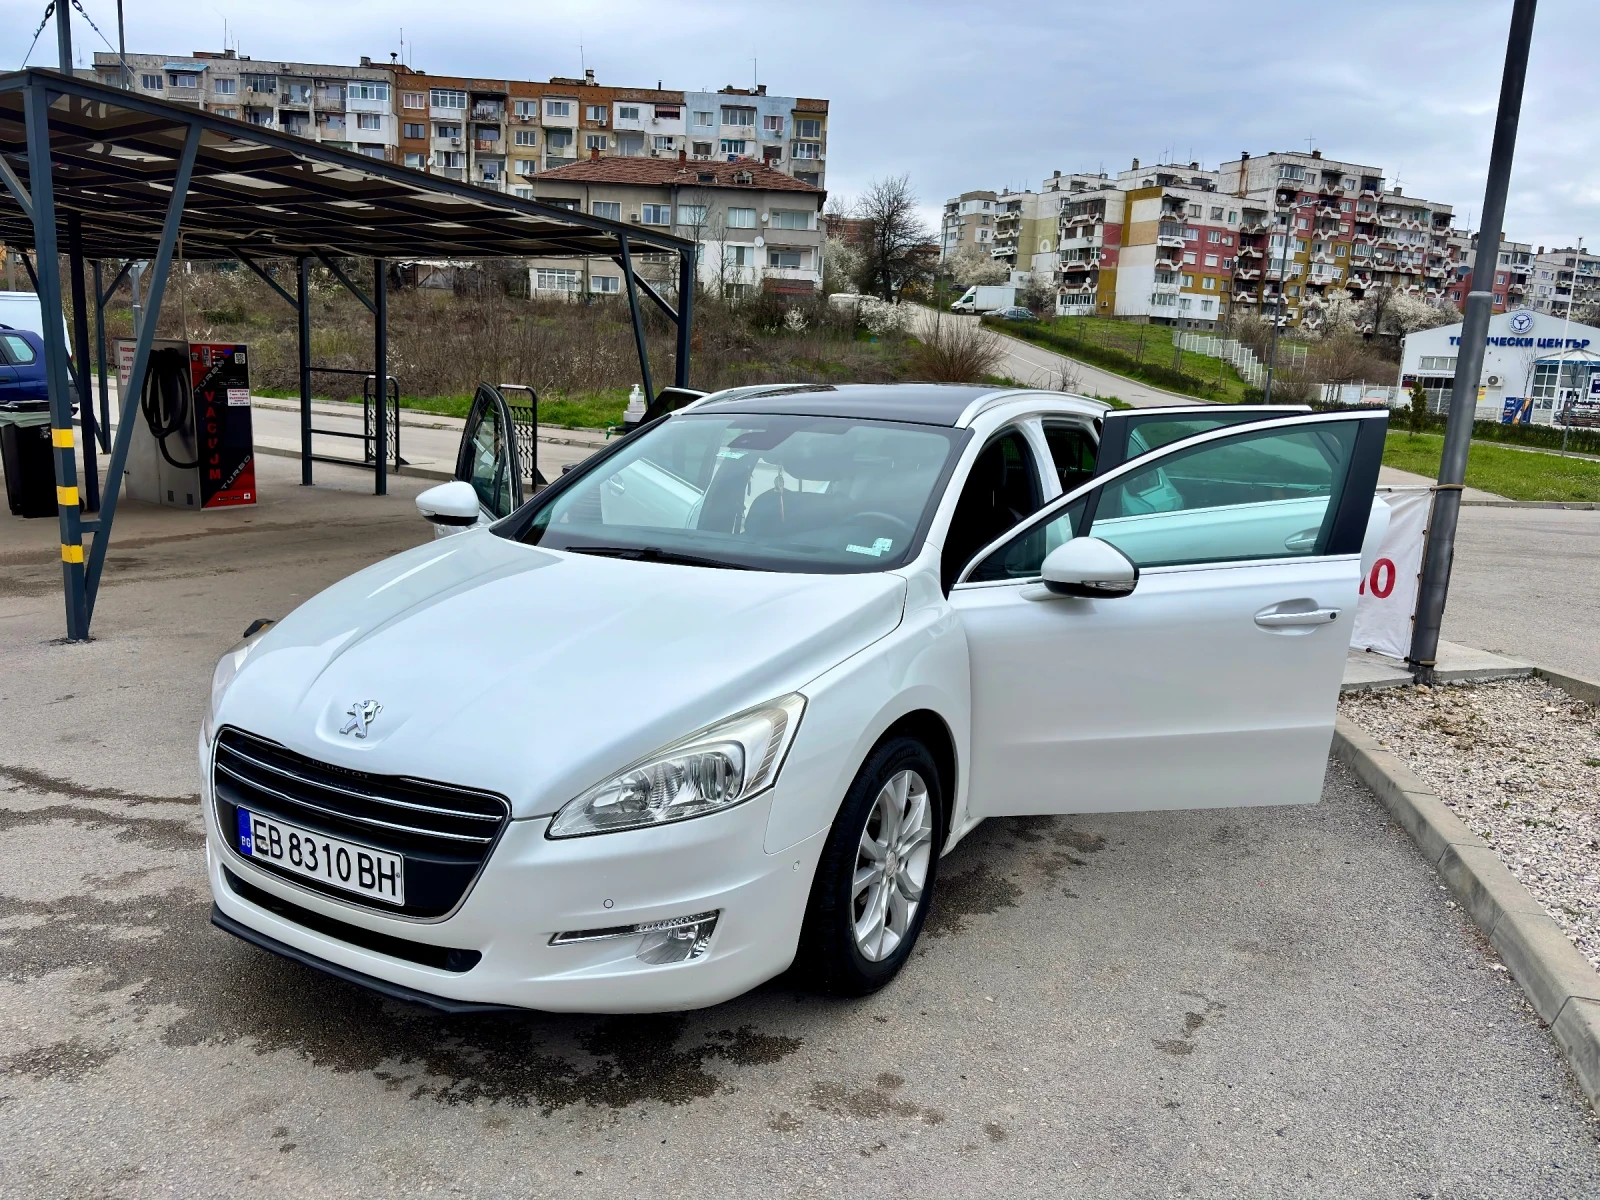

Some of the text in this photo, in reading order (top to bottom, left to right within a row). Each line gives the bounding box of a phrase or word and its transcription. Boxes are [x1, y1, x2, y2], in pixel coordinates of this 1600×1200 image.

[1537, 338, 1590, 349] ЦЕНТЪР
[220, 455, 251, 490] TURBO
[241, 835, 251, 848] BG
[253, 819, 397, 897] EB 8310 BH
